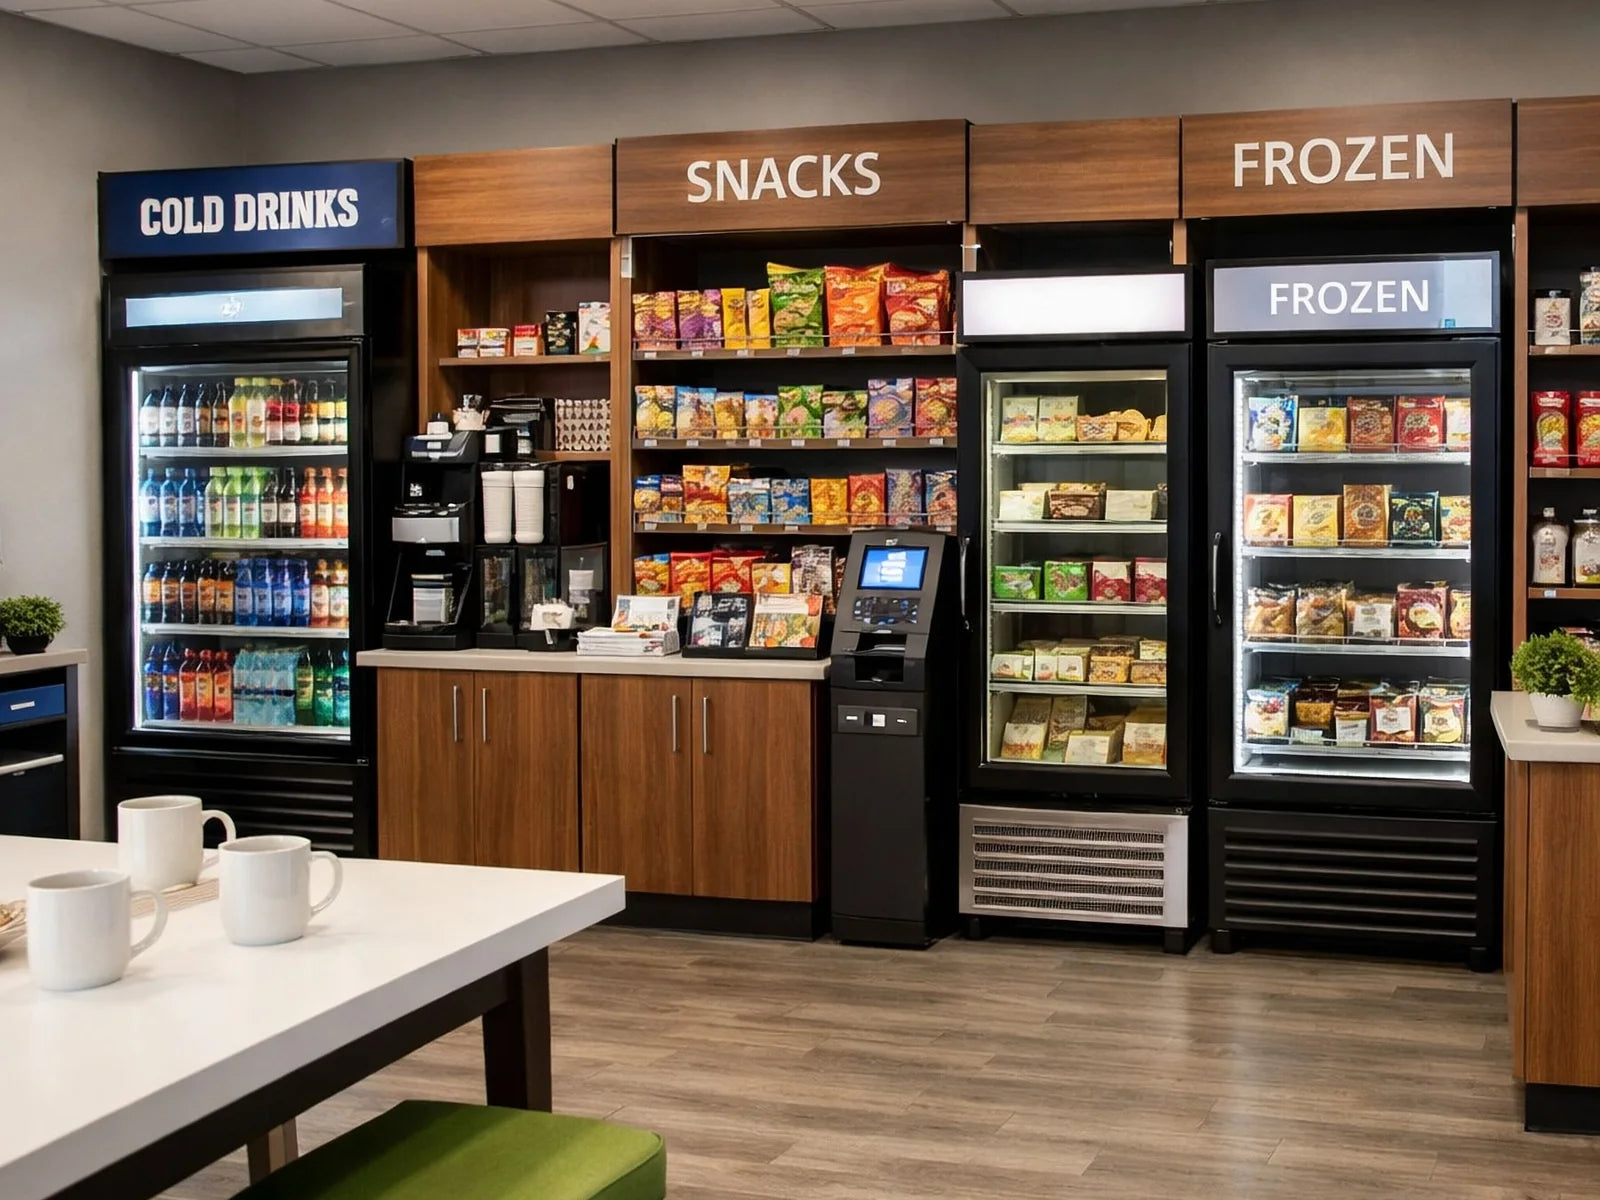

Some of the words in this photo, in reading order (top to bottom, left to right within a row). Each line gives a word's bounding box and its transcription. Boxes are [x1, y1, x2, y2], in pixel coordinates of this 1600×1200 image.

[687, 151, 881, 204] SNACKS
[1234, 132, 1454, 187] FROZEN
[140, 195, 224, 236] COLD
[233, 187, 359, 232] DRINKS
[1270, 279, 1429, 315] FROZEN
